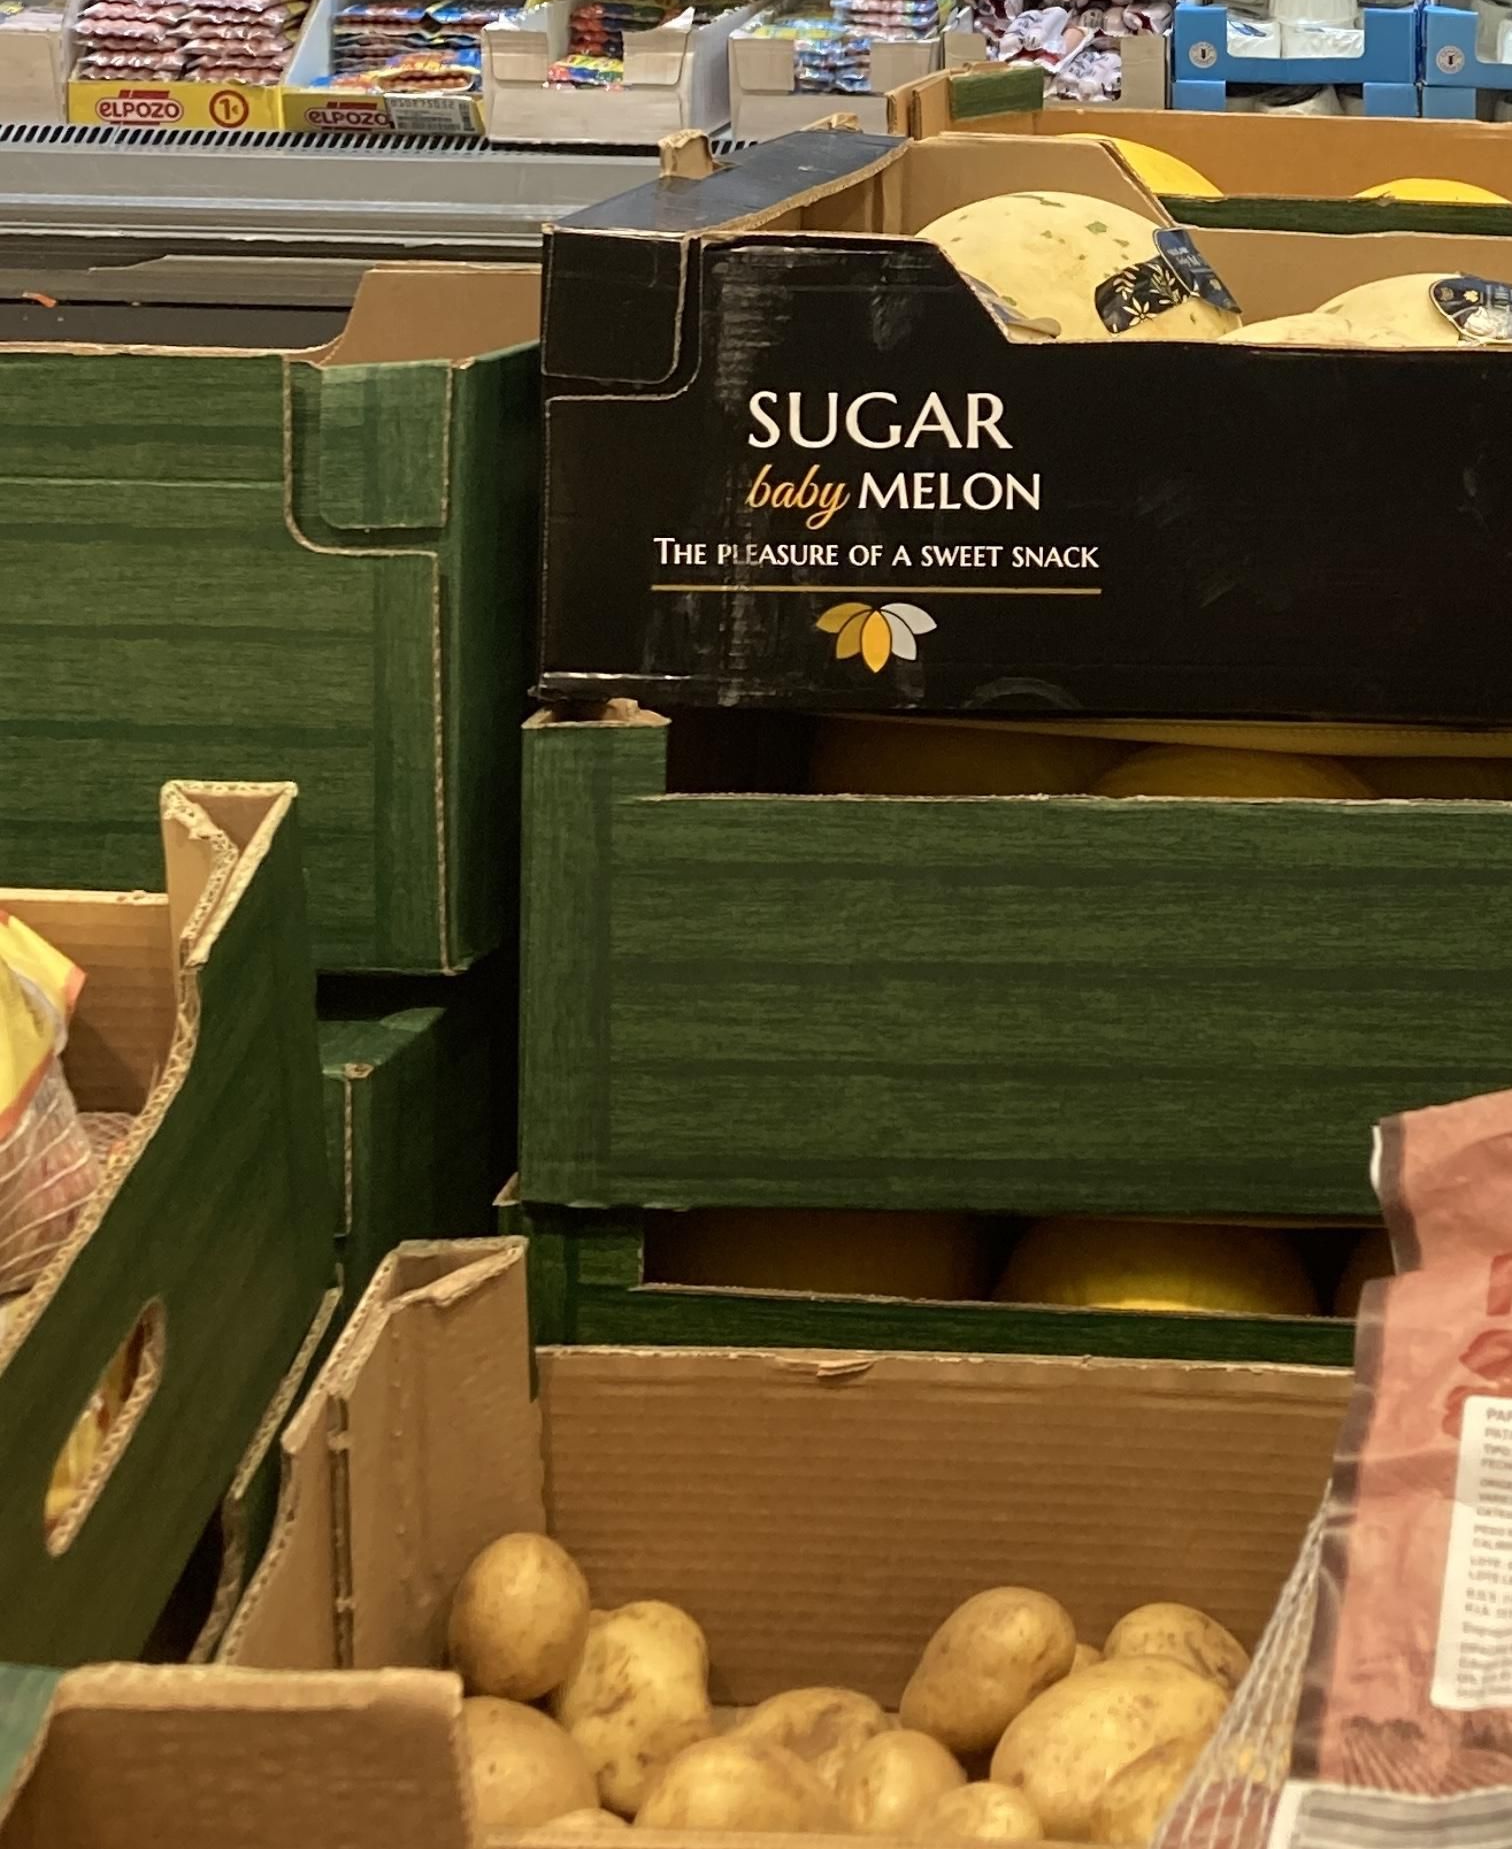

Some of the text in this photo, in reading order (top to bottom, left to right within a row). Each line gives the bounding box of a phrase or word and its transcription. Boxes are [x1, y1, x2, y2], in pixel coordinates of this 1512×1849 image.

[748, 390, 1013, 450] SUGAR
[745, 464, 1041, 531] baby MELON
[653, 537, 1100, 569] THE PLEASURE OF A SWEET SNACK
